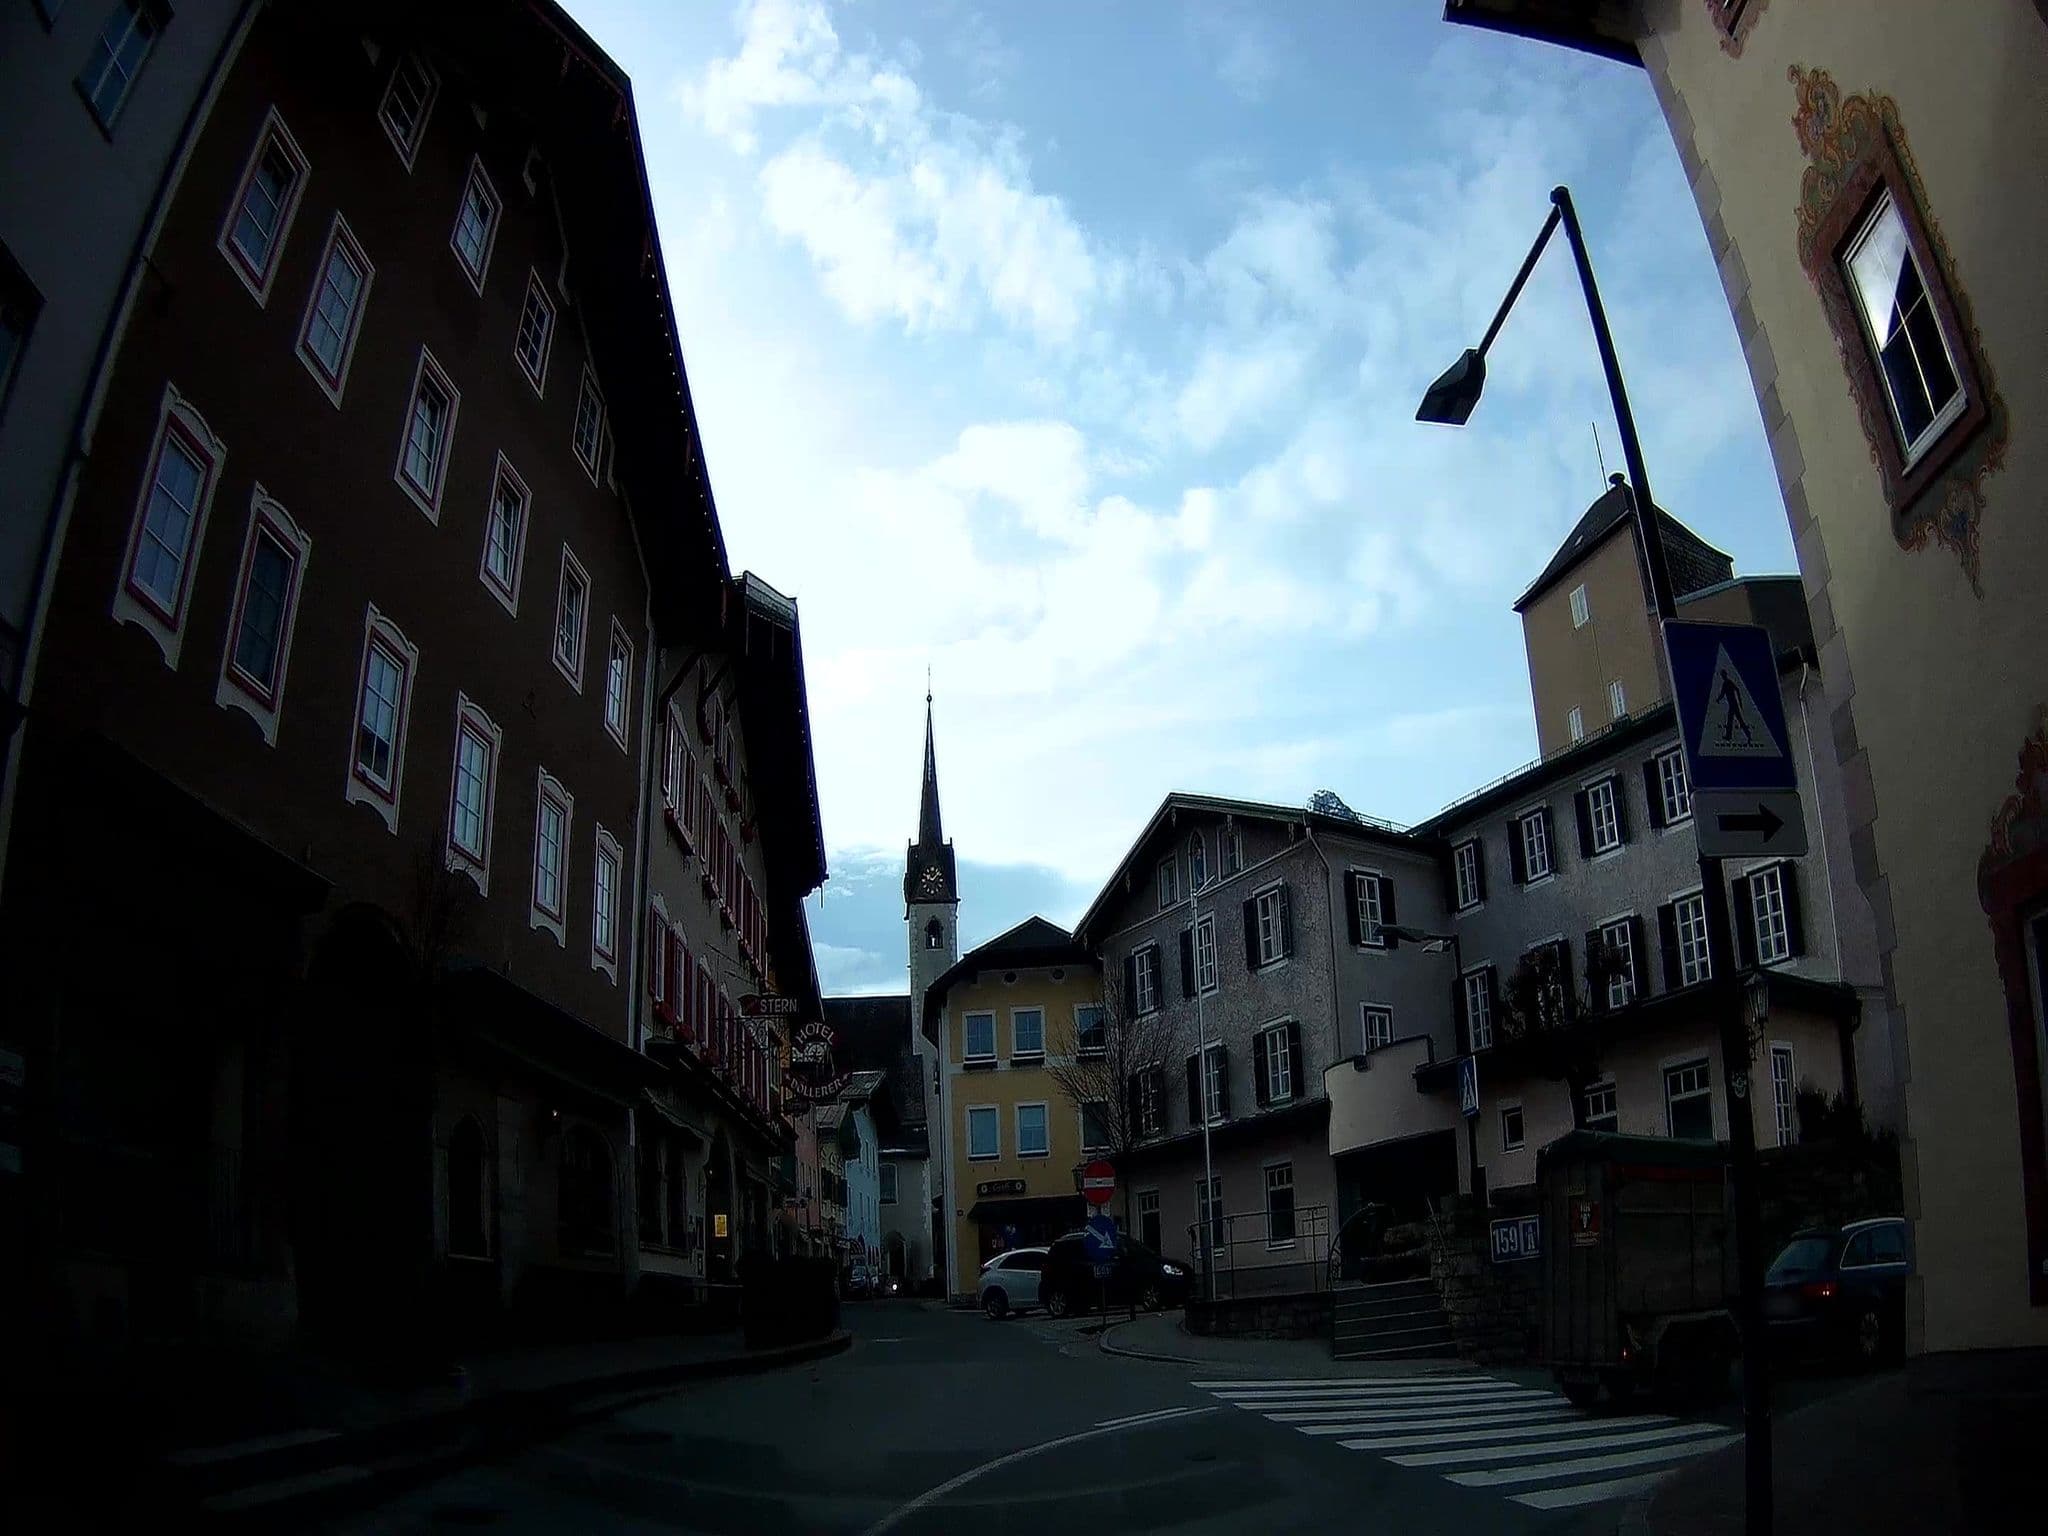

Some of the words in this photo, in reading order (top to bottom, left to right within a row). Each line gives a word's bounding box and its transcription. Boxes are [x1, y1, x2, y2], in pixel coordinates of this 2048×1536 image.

[760, 998, 797, 1013] STERN
[795, 1022, 834, 1044] HOTEL
[1493, 1226, 1519, 1255] 159
